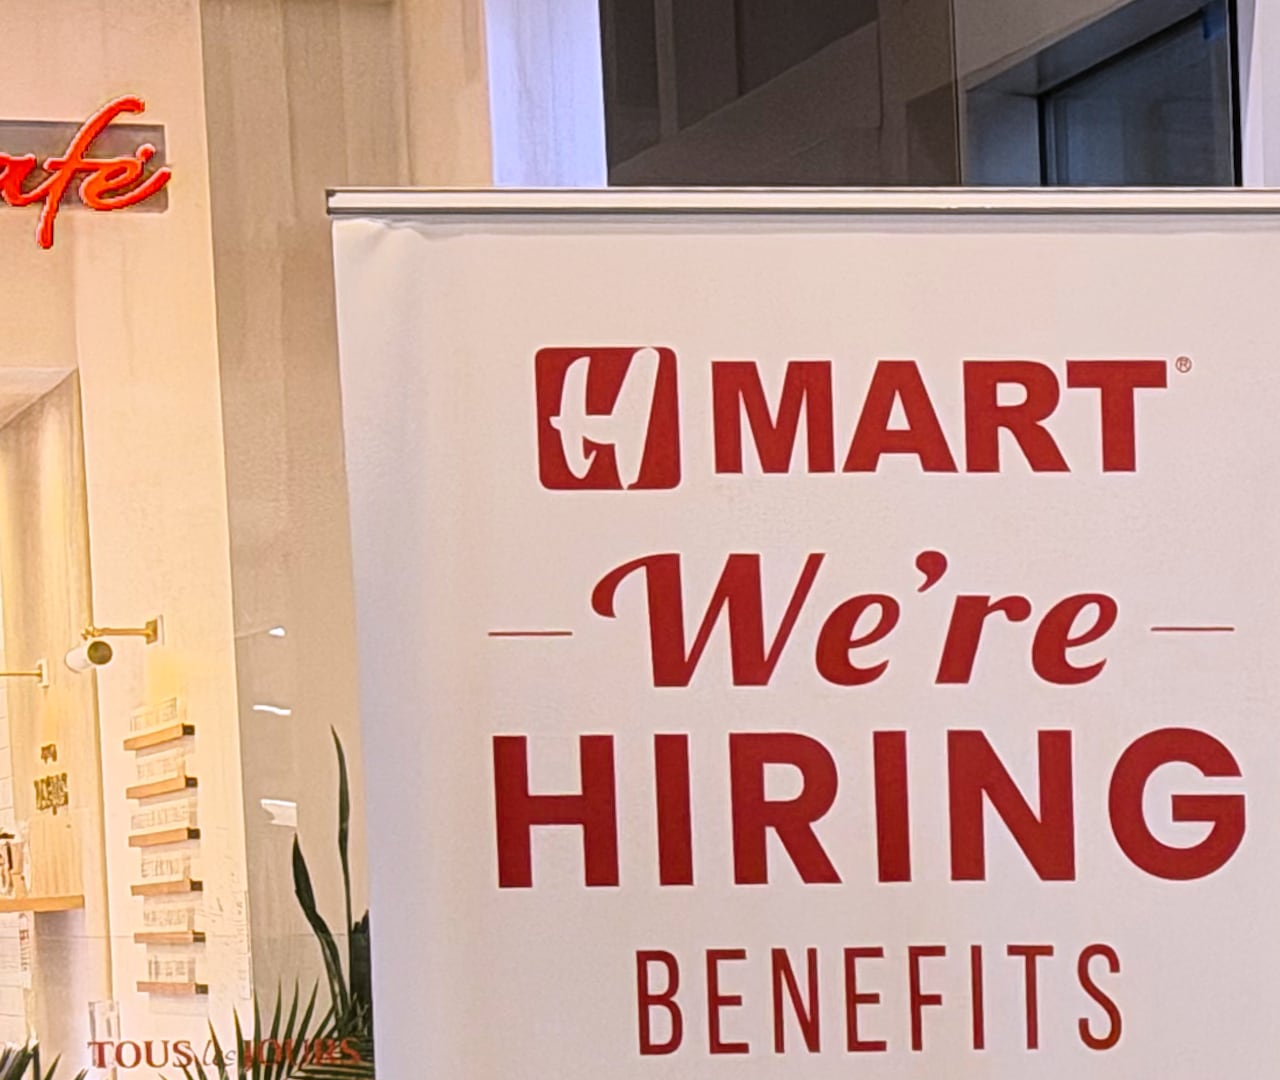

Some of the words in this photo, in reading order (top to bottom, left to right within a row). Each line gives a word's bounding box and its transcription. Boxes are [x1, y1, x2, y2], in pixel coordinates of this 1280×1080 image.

[712, 360, 1167, 473] MART
[591, 550, 1117, 687] We're
[493, 727, 1246, 888] HIRING
[87, 1040, 193, 1069] TOUS
[636, 944, 1122, 1056] BENEFITS
